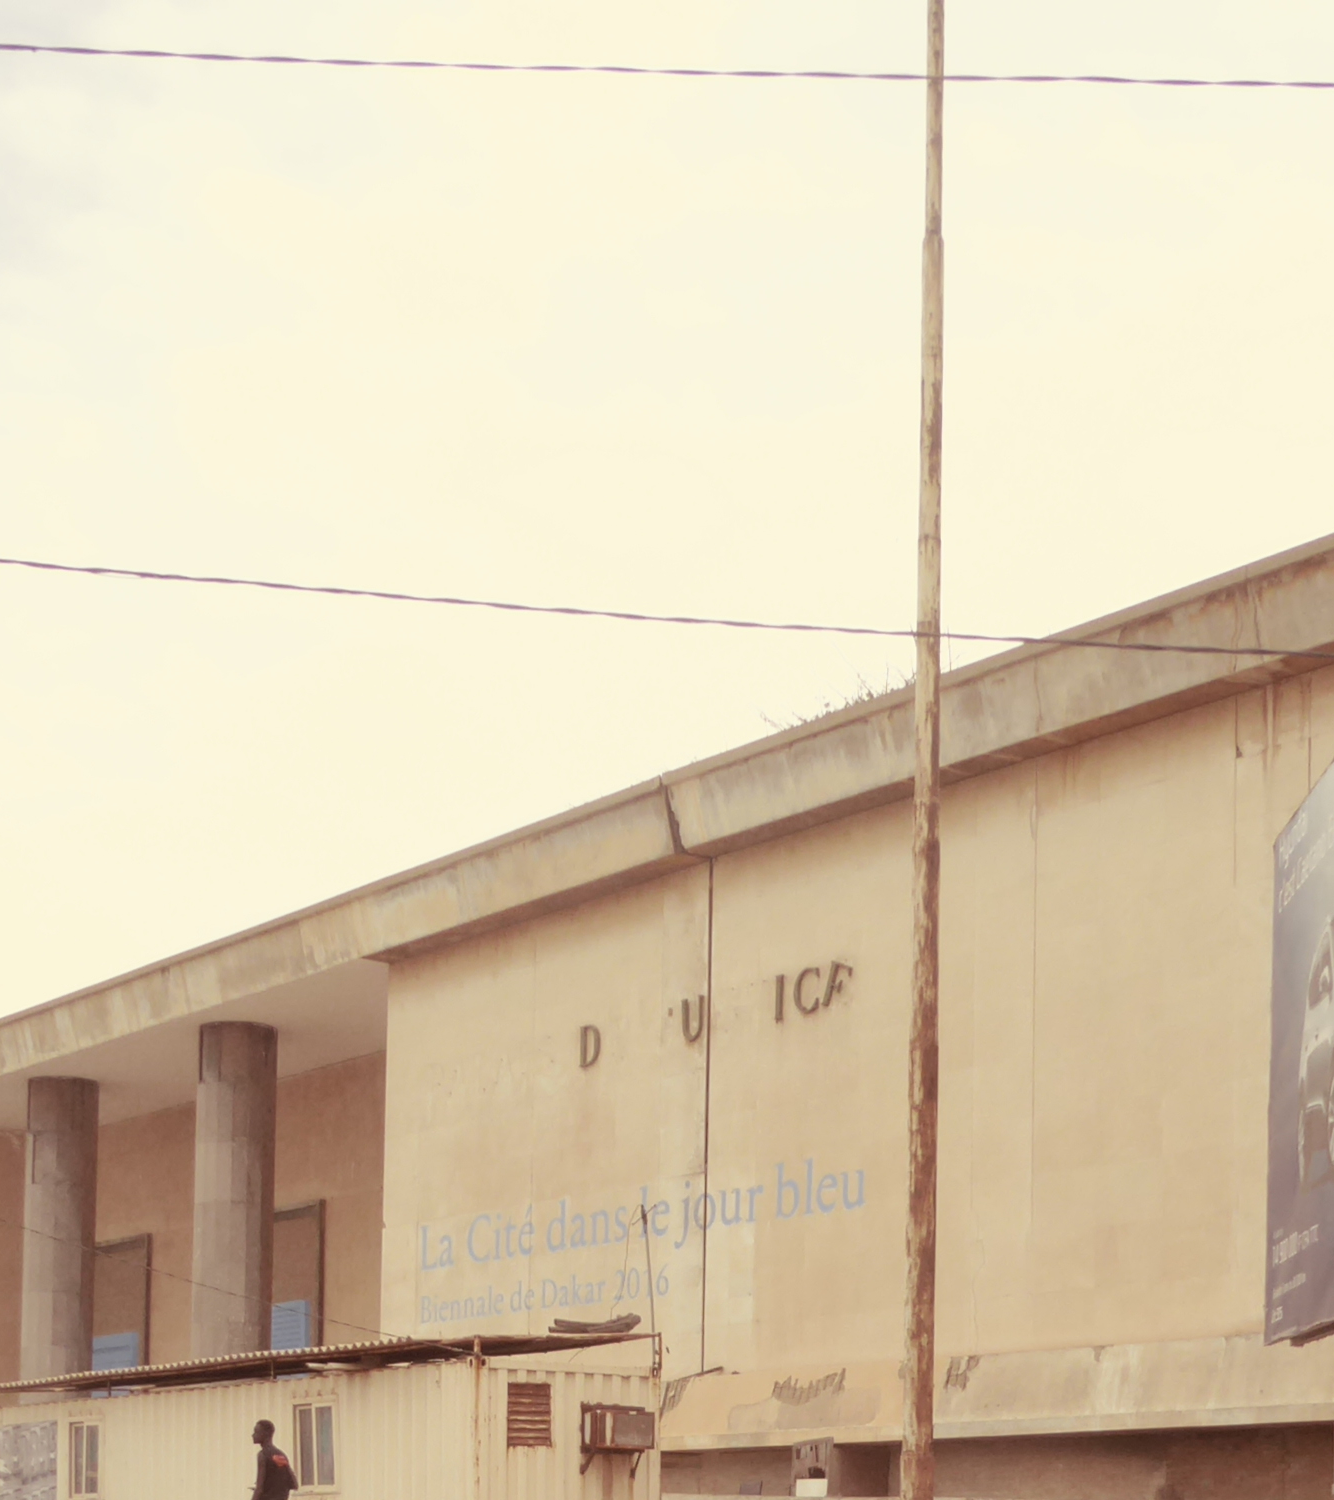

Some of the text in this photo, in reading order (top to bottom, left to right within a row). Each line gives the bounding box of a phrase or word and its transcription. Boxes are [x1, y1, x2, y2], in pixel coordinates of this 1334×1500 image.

[421, 1225, 454, 1271] La
[467, 1204, 535, 1263] Cité
[546, 1196, 627, 1254] dans
[674, 1181, 763, 1249] jour
[775, 1158, 866, 1220] bleu
[420, 1263, 669, 1324] Biennale de Dakar 2016
